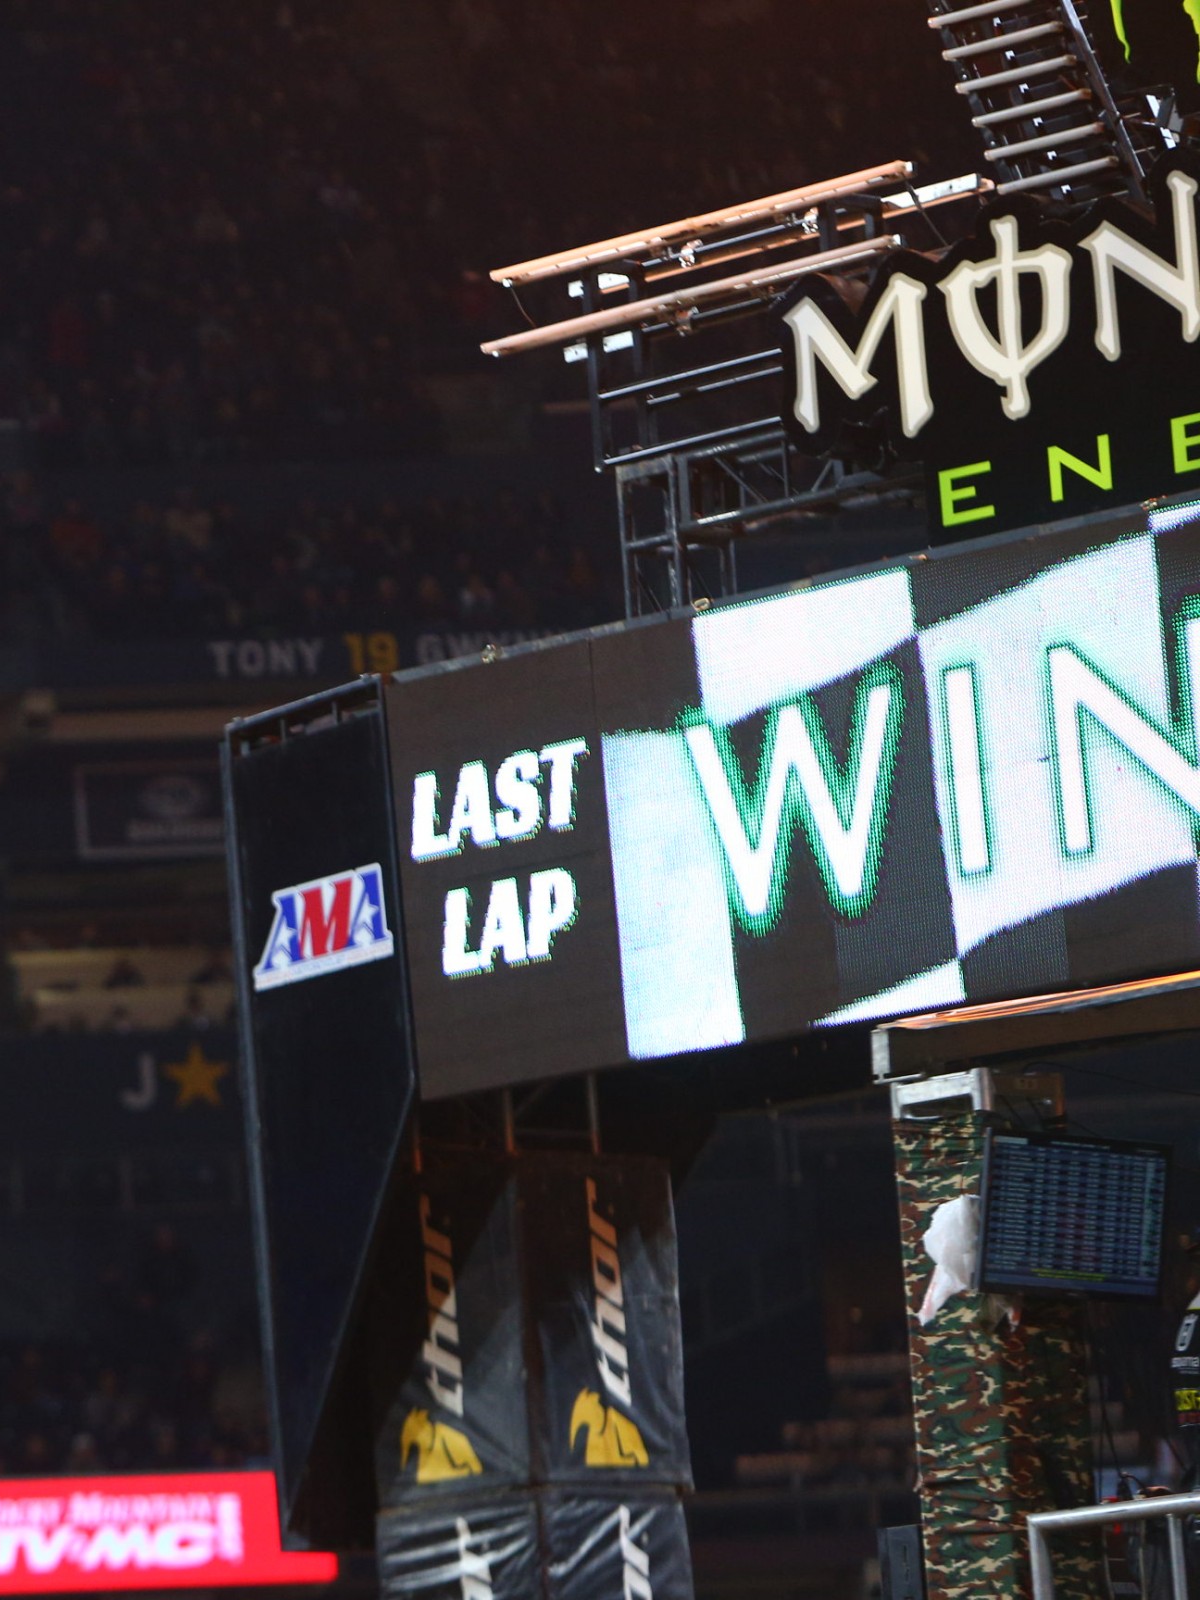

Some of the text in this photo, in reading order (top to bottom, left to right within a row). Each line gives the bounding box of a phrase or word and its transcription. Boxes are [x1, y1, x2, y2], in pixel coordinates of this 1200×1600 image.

[208, 637, 324, 676] TONY
[345, 632, 398, 678] 19
[411, 737, 590, 863] LAST
[263, 870, 387, 971] AMA
[442, 867, 579, 978] LAP
